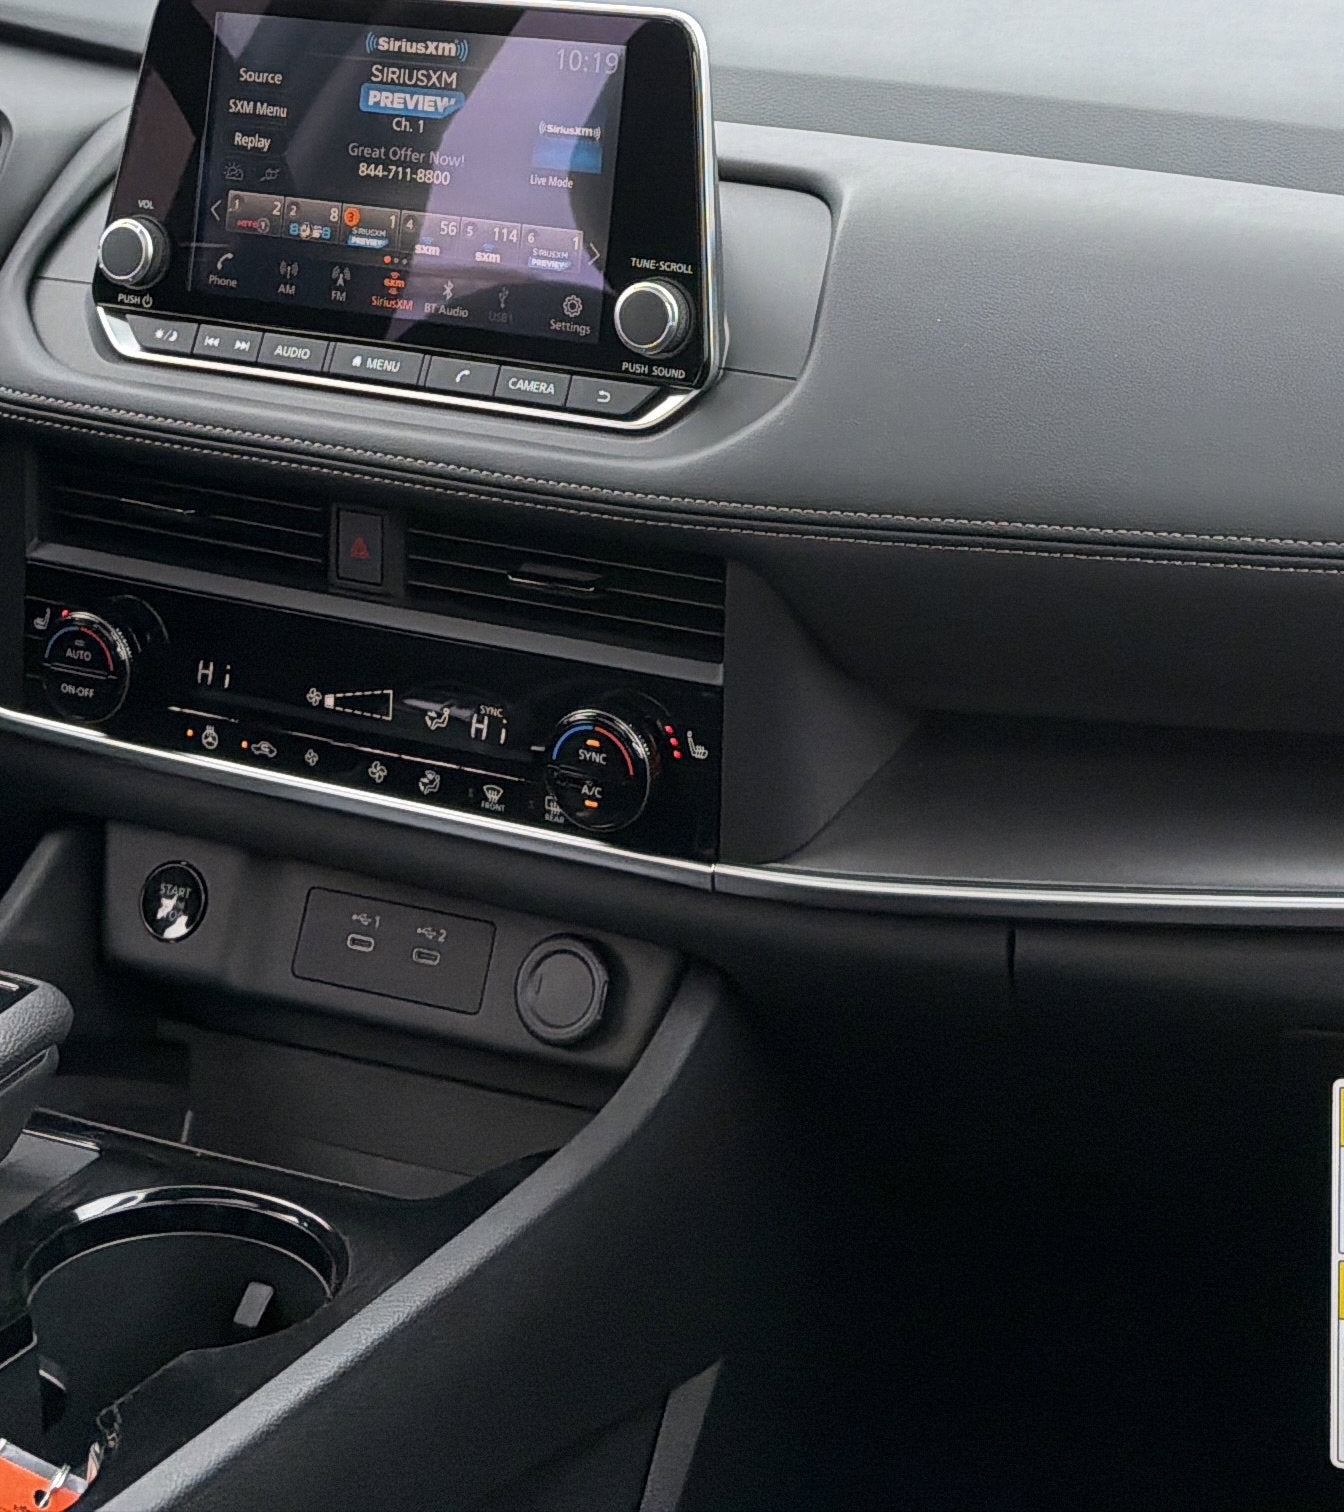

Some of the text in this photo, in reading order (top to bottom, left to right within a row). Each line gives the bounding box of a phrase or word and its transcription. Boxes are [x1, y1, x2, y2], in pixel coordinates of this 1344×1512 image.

[557, 48, 619, 75] 10:19
[240, 67, 283, 85] Source
[371, 65, 457, 88] SIRIUSXM
[229, 99, 287, 118] SXM Menu
[368, 90, 457, 112] PREVIEW
[392, 118, 424, 133] Ch. 1
[234, 131, 271, 152] Replay
[348, 142, 465, 166] Great Offer Now!
[358, 162, 451, 185] 844-711-8800
[530, 174, 573, 188] Live Mode
[137, 199, 154, 210] VOL
[272, 201, 281, 216] 2
[329, 207, 339, 222] 8
[440, 220, 457, 236] 56
[493, 226, 518, 243] 114
[118, 293, 141, 305] PUSH
[209, 274, 592, 337] Phone AM FM SiriusXM BT Audio Settings
[273, 345, 311, 360] AUDIO
[366, 357, 401, 373] MENU
[622, 361, 686, 379] PUSH SOUND
[508, 377, 556, 395] CAMERA
[65, 647, 92, 662] AUTO
[480, 704, 504, 717] SYNC
[578, 749, 607, 765] SYNC
[581, 784, 603, 799] A/C
[480, 800, 505, 813] FRONT
[544, 813, 565, 824] REAR
[159, 883, 192, 899] START
